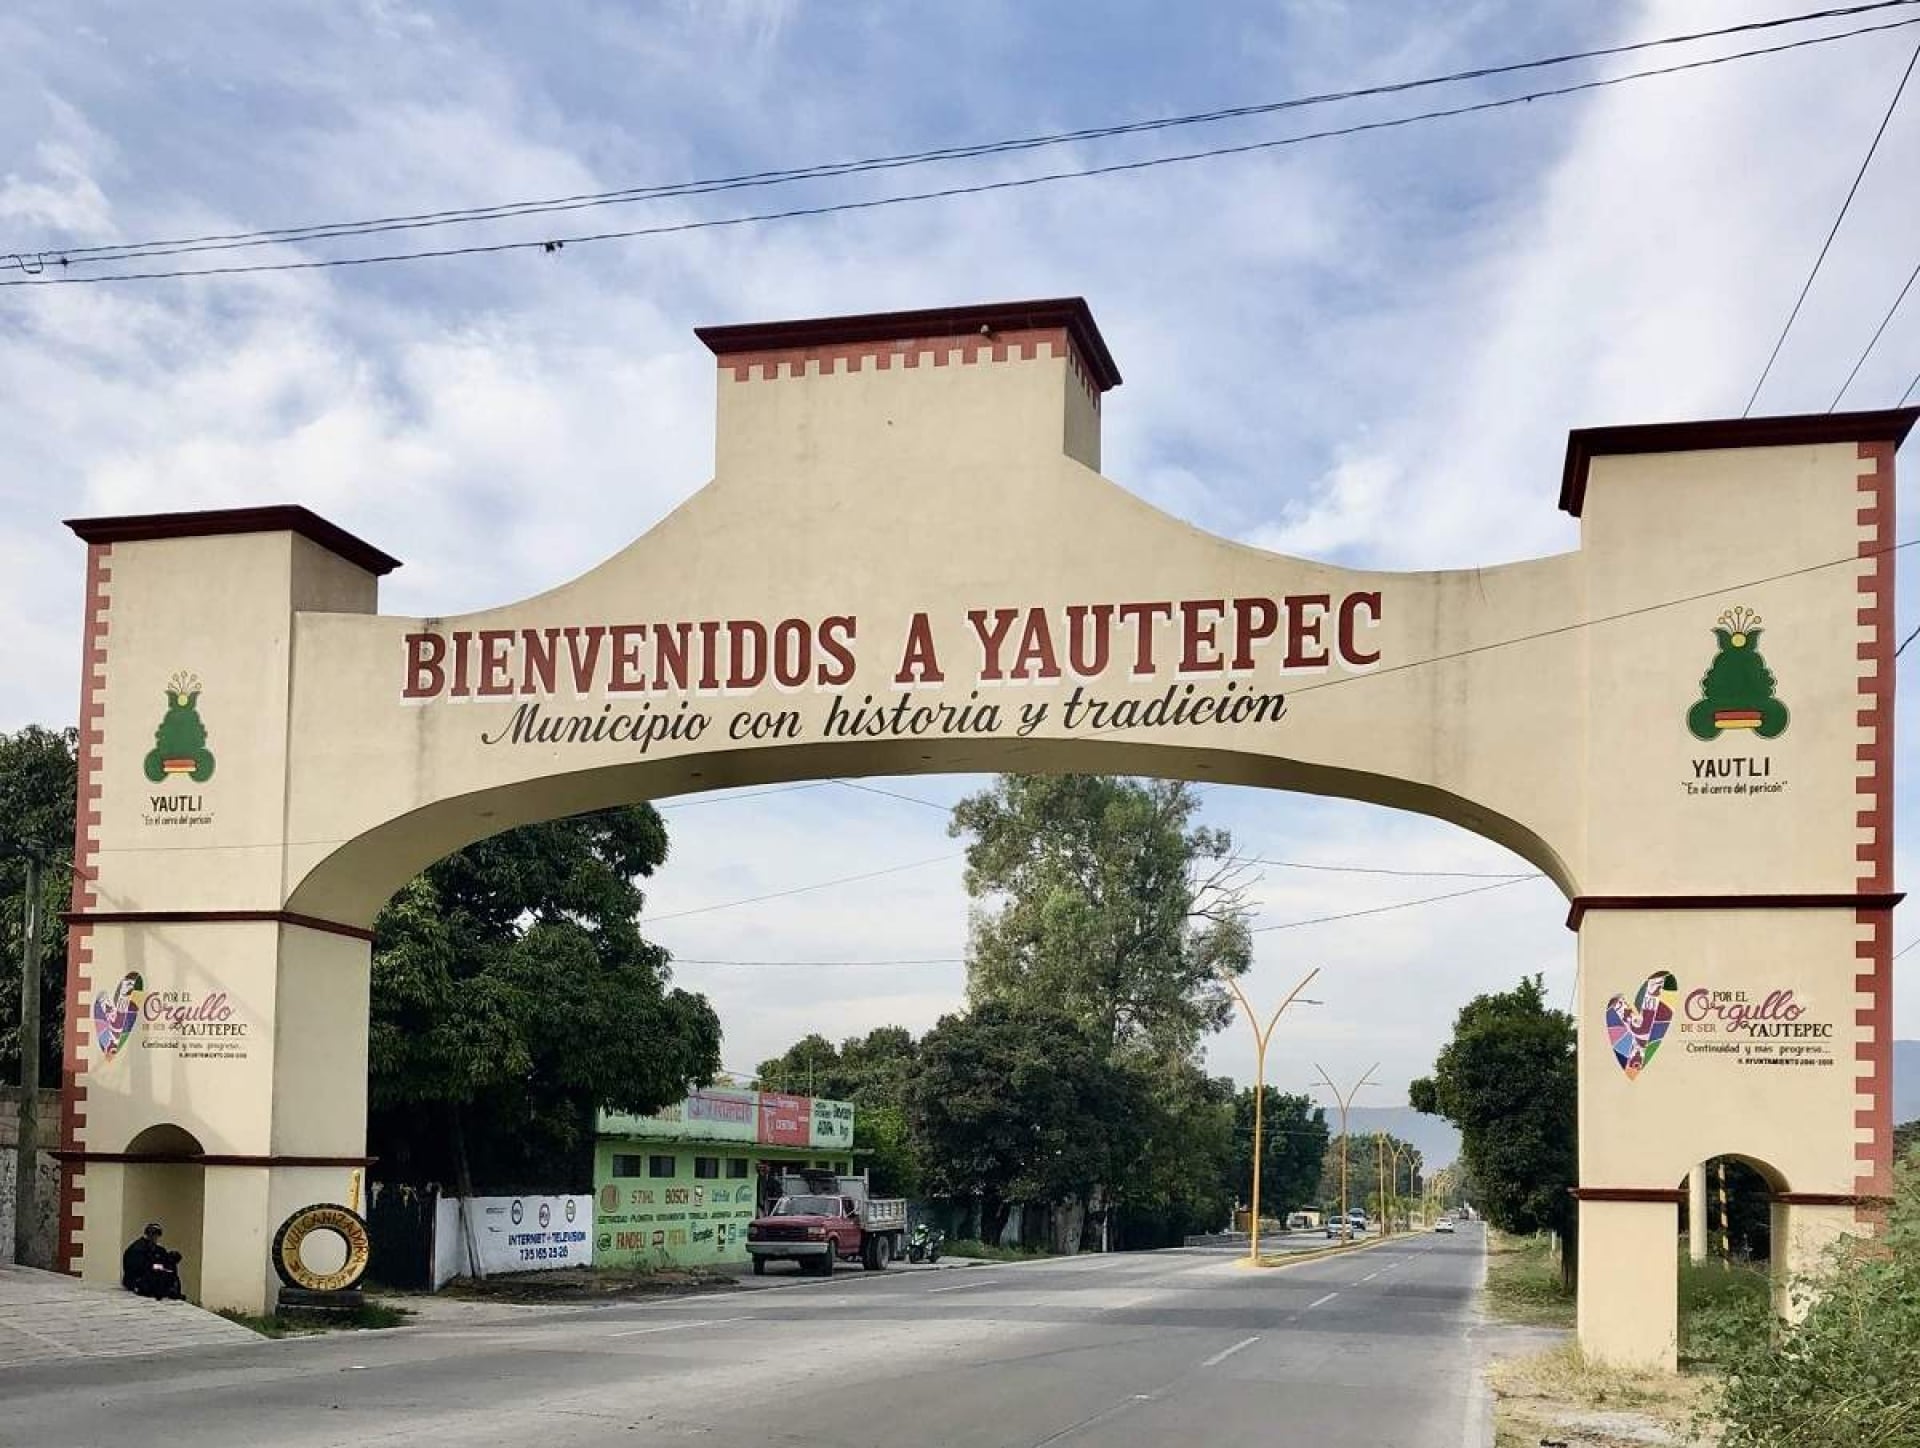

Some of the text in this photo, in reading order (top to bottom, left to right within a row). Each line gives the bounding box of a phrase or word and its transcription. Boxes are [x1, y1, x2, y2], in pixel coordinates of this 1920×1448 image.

[402, 591, 1382, 700] BIENVENIDOS A YAUTEPEC
[481, 680, 1288, 754] Municipio con historia y tradición
[1692, 756, 1770, 778] YAUTLI
[1734, 781, 1747, 795] del
[150, 795, 203, 812] YAUTLI
[163, 991, 192, 1002] POR EL
[1713, 991, 1748, 1002] POR EL
[143, 991, 235, 1028] Orgullo
[1685, 988, 1806, 1033] Orgullo
[181, 1023, 248, 1036] YAUTEPEC
[1681, 1023, 1833, 1038] DE SER YAUTEPEC
[1744, 1045, 1751, 1056] y
[508, 1232, 546, 1246] INTERNET
